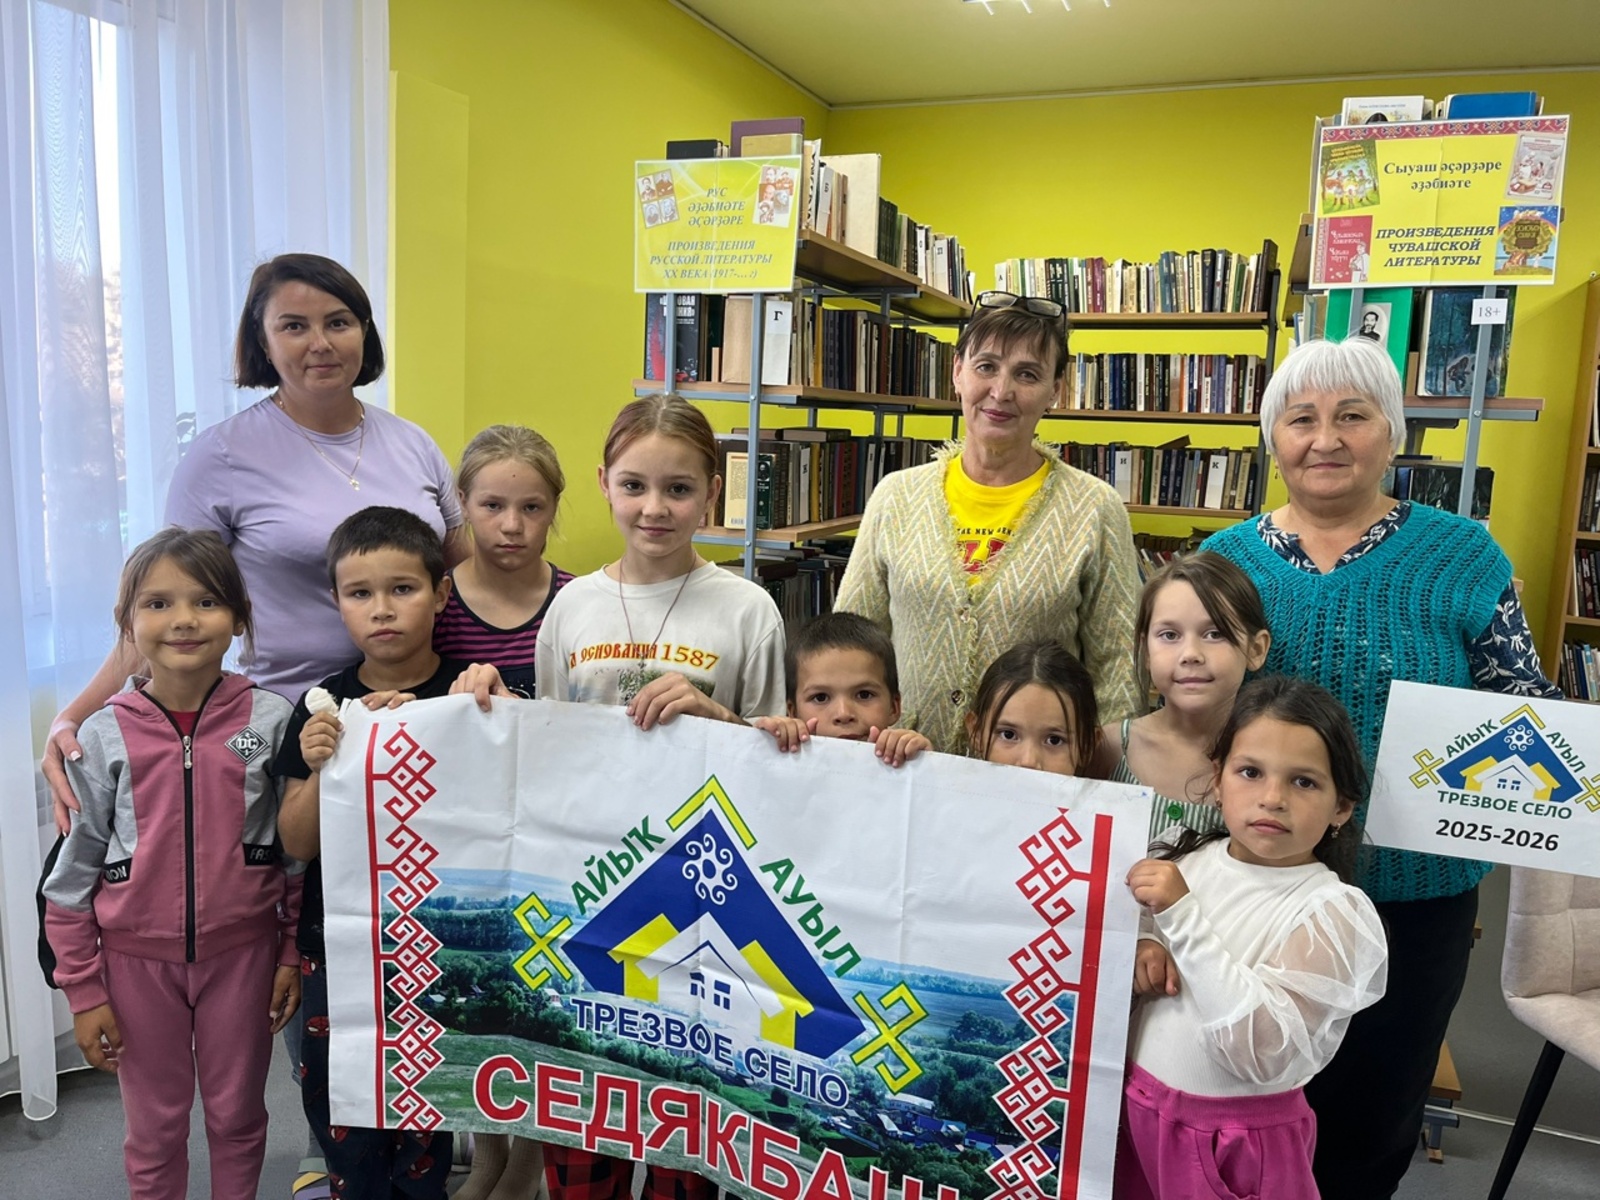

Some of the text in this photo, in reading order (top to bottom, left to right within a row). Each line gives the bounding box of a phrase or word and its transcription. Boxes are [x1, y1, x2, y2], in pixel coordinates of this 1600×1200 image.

[1384, 162, 1437, 175] Сыуаш
[1375, 226, 1496, 239] ПРОИЗВЕДЕНИЯ
[667, 240, 755, 251] ПРОИЗВЕДЕНИЯ
[1388, 238, 1481, 252] ЧУВАШСКОЙ
[650, 254, 773, 265] РУССКОЙ ЛИТЕРАТУРЫ
[1384, 255, 1482, 267] ЛИТЕРАТУРЫ
[680, 269, 707, 279] ВЕКА
[774, 311, 783, 321] Г
[1478, 306, 1501, 318] 18+
[662, 644, 720, 671] 1587
[1445, 718, 1586, 773] АЙЫҠ АУЫЛ
[1437, 790, 1572, 820] ТРЕЗВОЕ СЕЛО
[1435, 819, 1560, 851] 2025-2026
[569, 815, 862, 978] АЙЫҠ АУЫЛ
[571, 998, 849, 1108] ТРЕЗВОЕ СЕЛО
